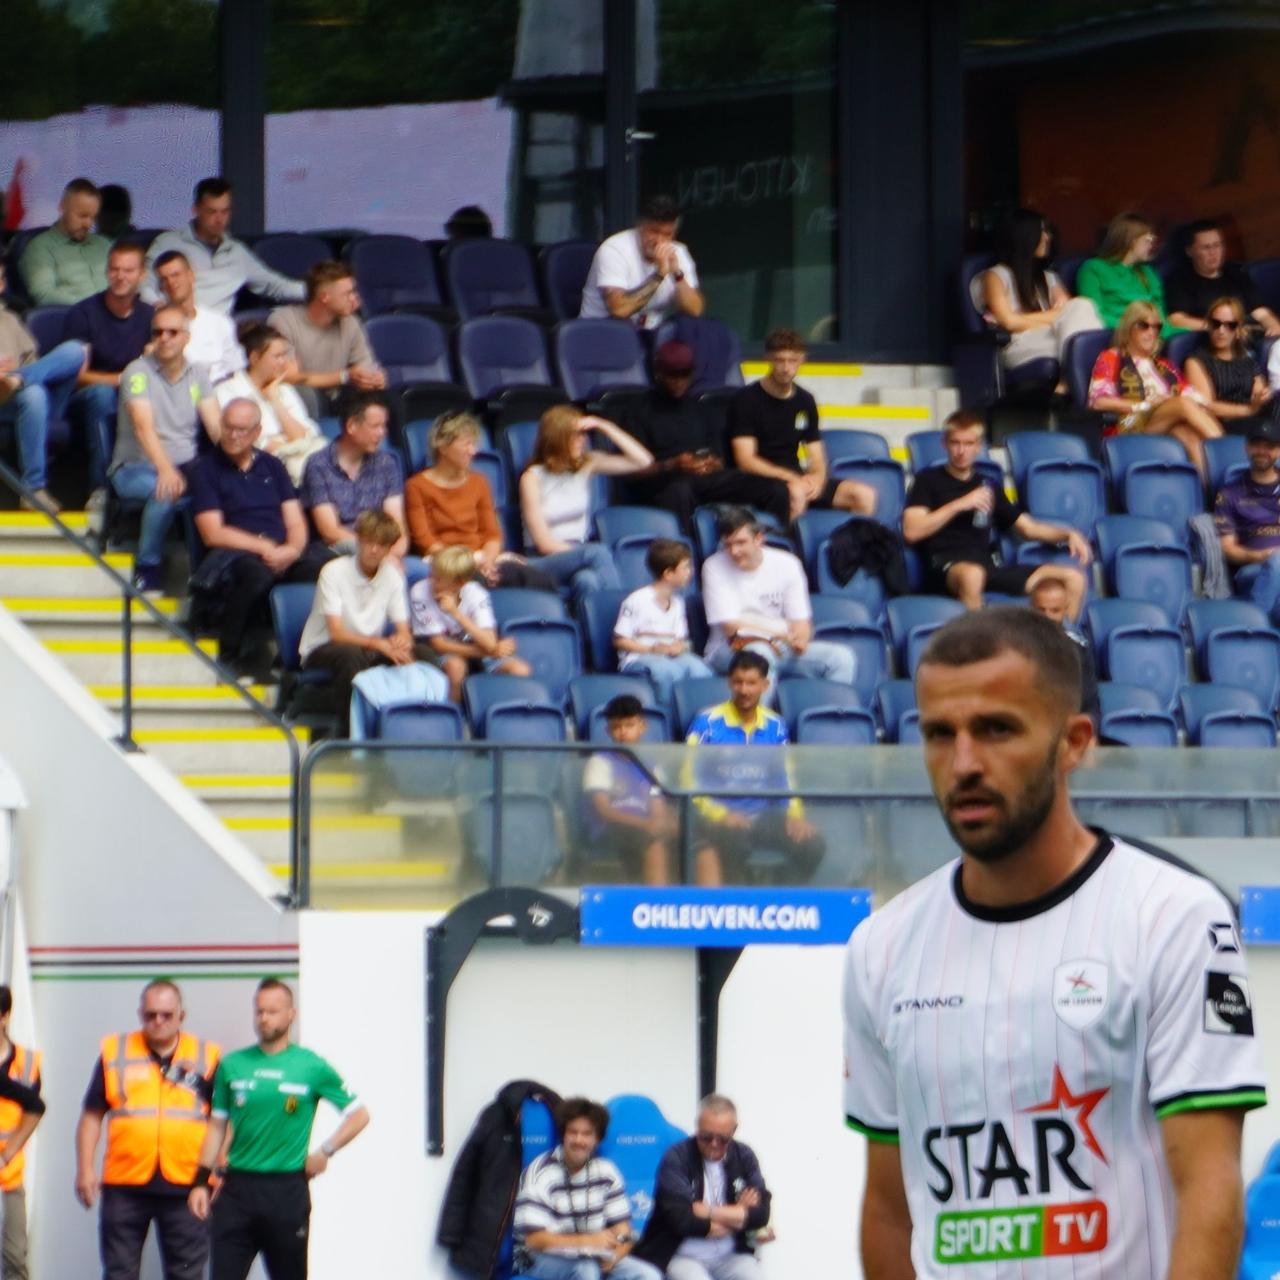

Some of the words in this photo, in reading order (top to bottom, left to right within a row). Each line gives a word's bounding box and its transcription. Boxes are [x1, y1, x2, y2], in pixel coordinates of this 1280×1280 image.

[632, 902, 819, 930] OHLEUVEN.COM
[922, 1117, 1094, 1202] STAR
[940, 1213, 1039, 1257] SPORT
[1053, 1209, 1104, 1245] TV
